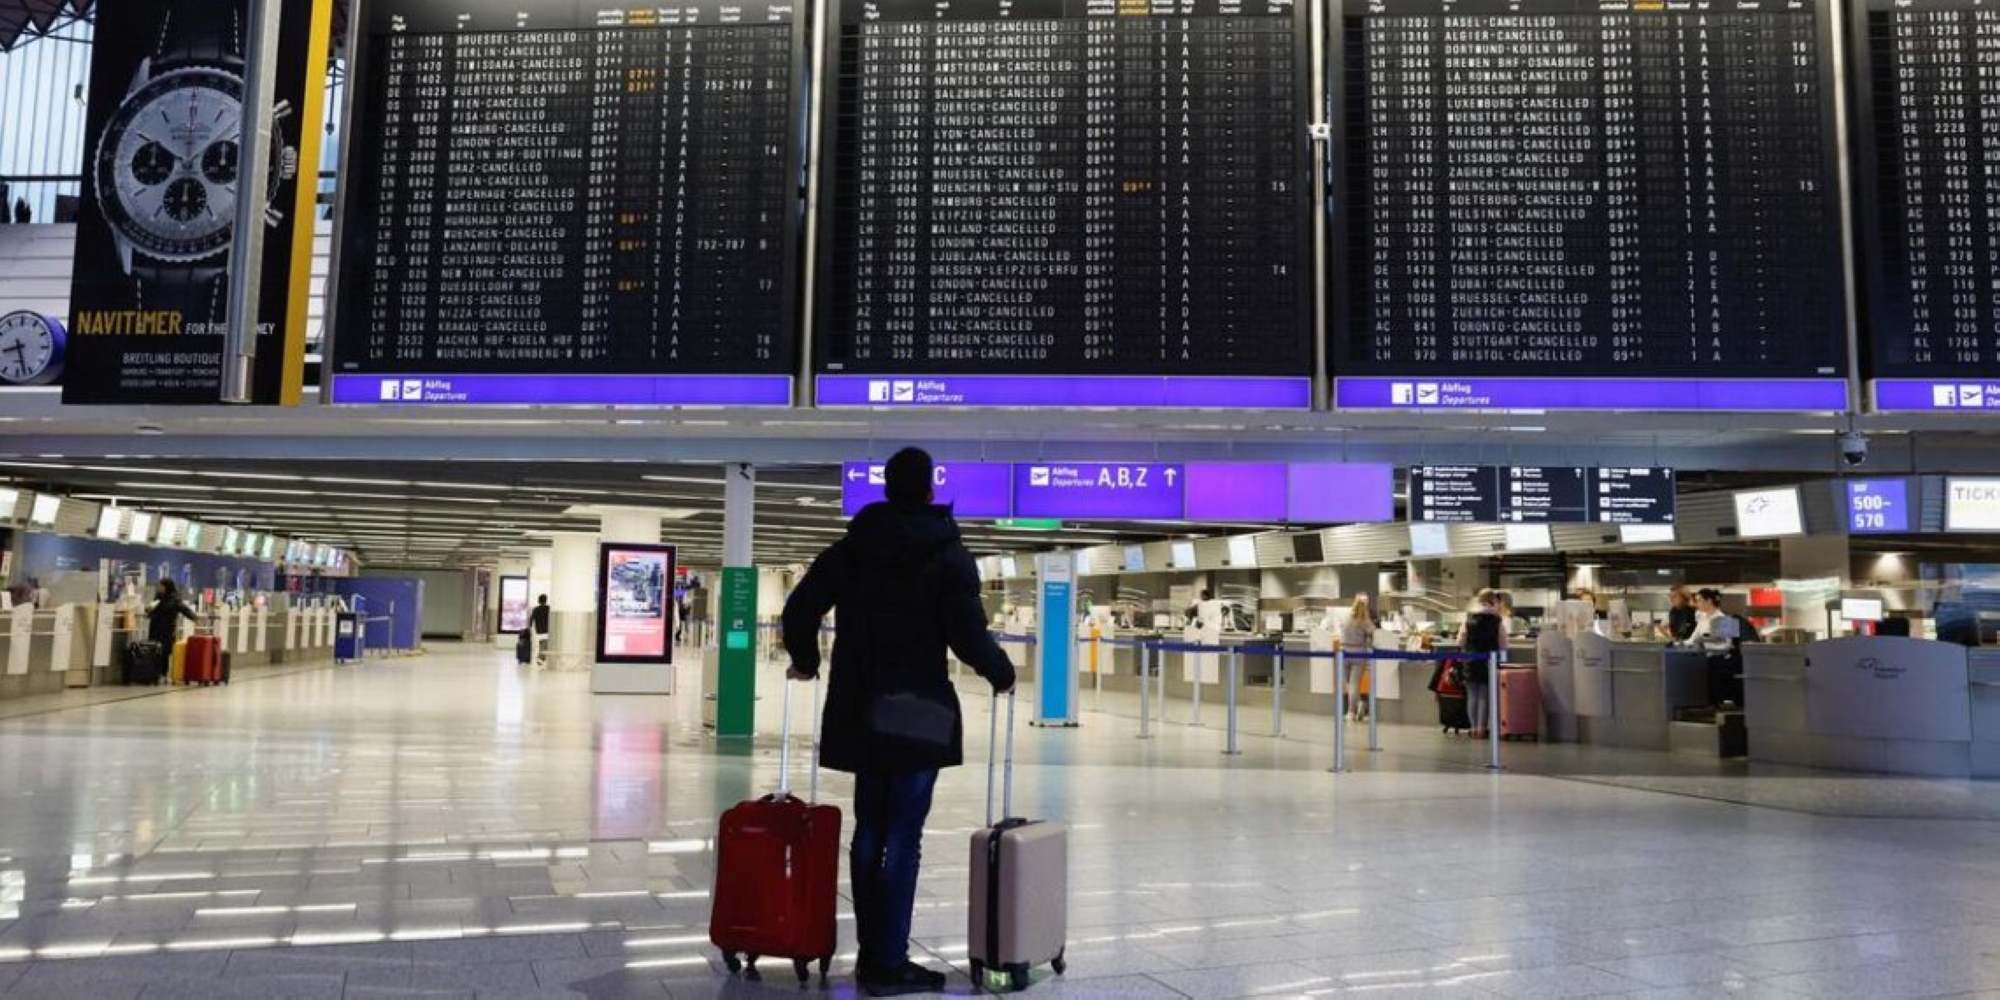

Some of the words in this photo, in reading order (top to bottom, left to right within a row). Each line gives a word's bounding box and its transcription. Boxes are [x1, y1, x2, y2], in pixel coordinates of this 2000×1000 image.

[937, 21, 1057, 34] CHICAGO-CANCELLED
[1402, 18, 1428, 28] 1202
[1444, 17, 1555, 28] BASEL-CANCELLED
[1446, 30, 1564, 41] ALGIER-CANCELLED
[1898, 26, 1912, 37] LH
[457, 32, 576, 45] BRUESSEL-CANCELLED
[936, 34, 1057, 47] MAILAND-CANCELLED
[391, 50, 404, 60] LH
[425, 49, 442, 59] 174
[456, 45, 562, 58] BERLIN-CANCELLED
[935, 48, 1050, 60] BERLIN-CANCELLED
[1445, 43, 1549, 55] DORTMUND-KOELN
[417, 61, 441, 72] 1470
[456, 57, 582, 71] TIMISOARA-CANCELLED
[936, 61, 1071, 73] AMSTERDAM-CANCELLED
[417, 74, 440, 84] 1402
[455, 70, 582, 83] FUERTEVEN-CANCELLED
[1446, 71, 1460, 82] LA
[1469, 70, 1587, 81] ROMANA-CANCELLED
[1941, 66, 1961, 77] 122
[935, 74, 1050, 86] NANTES-CANCELLED
[1941, 80, 1962, 91] 244
[935, 87, 1064, 100] SALZBURG-CANCELLED
[1446, 84, 1526, 95] DUESSELDORF
[453, 97, 546, 109] WIEN-CANCELLED
[1447, 98, 1589, 109] LUXEMBURG-CANCELLED
[1901, 95, 1915, 106] DE
[935, 101, 1057, 113] ZUERICH-CANCELLED
[452, 110, 545, 122] PISA-CANCELLED
[935, 114, 1057, 126] VENEDIG-CANCELLED
[1447, 111, 1582, 122] MUENSTER-CANCELLED
[451, 123, 564, 135] HAMBURG-CANCELLED
[934, 128, 1034, 140] LYON-CANCELLED
[1373, 126, 1387, 137] LH
[1411, 126, 1432, 136] 370
[451, 136, 557, 148] LONDON-CANCELLED
[933, 142, 1041, 153] PALMA-CANCELLED
[1412, 140, 1432, 150] 142
[1448, 139, 1591, 150] NUERNBERG-CANCELLED
[934, 155, 1034, 167] WIEN-CANCELLED
[1449, 153, 1583, 164] LISSABON-CANCELLED
[1946, 151, 1966, 161] 440
[449, 162, 542, 174] GRAZ-CANCELLED
[1413, 167, 1432, 178] 417
[1449, 167, 1569, 178] ZAGREB-CANCELLED
[933, 169, 1064, 180] BRUESSEL-CANCELLED
[449, 175, 548, 187] TURIN-CANCELLED
[447, 188, 575, 200] KOPENHAGE-CANCELLED
[1940, 193, 1969, 204] 1142
[932, 196, 1056, 207] HAMBURG-CANCELLED
[1449, 195, 1592, 205] GOETEBORG-CANCELLED
[446, 201, 573, 213] MARSEILLE-CANCELLED
[932, 210, 1056, 221] LEIPZIG-CANCELLED
[1449, 209, 1585, 219] HELSINKI-CANCELLED
[860, 224, 873, 235] LH
[932, 223, 1055, 235] MAILAND-CANCELLED
[1374, 223, 1389, 233] LH
[1407, 223, 1433, 233] 1322
[1452, 223, 1563, 233] TUNIS-CANCELLED
[1950, 222, 1971, 233] 454
[444, 228, 565, 239] MUENCHEN-CANCELLED
[931, 237, 1048, 248] LONDON-CANCELLED
[1452, 237, 1563, 247] IZMIR-CANCELLED
[931, 251, 1070, 262] LJUBLJANA-CANCELLED
[1451, 251, 1564, 261] PARIS-CANCELLED
[1452, 265, 1594, 275] TENERIFFA-CANCELLED
[1911, 265, 1926, 276] LH
[1945, 265, 1973, 276] 1394
[930, 279, 1047, 290] LONDON-CANCELLED
[1375, 279, 1389, 289] EK
[1451, 279, 1564, 290] DUBAI-CANCELLED
[440, 295, 541, 305] PARIS-CANCELLED
[930, 293, 1033, 303] GENF-CANCELLED
[1451, 293, 1587, 304] BRUESSEL-CANCELLED
[439, 308, 540, 319] NIZZA-CANCELLED
[930, 307, 1054, 317] MAILAND-CANCELLED
[1453, 307, 1581, 318] ZUERICH-CANCELLED
[77, 310, 182, 335] NAVITIMER
[185, 323, 206, 335] FOR
[439, 322, 547, 332] KRAKAU-CANCELLED
[930, 321, 1033, 331] LINZ-CANCELLED
[1377, 321, 1390, 332] AC
[1414, 322, 1435, 332] 841
[1454, 322, 1581, 332] TORONTO-CANCELLED
[1914, 323, 1929, 333] AA
[1956, 322, 1977, 333] 705
[928, 335, 1054, 345] DRESDEN-CANCELLED
[1376, 336, 1391, 346] LH
[1453, 336, 1597, 347] STUTTGART-CANCELLED
[123, 353, 171, 365] BREITLING
[173, 353, 221, 365] BOUTIQUE
[928, 348, 1047, 359] BREMEN-CANCELLED
[1453, 350, 1582, 361] BRISTOL-CANCELLED
[1916, 352, 1931, 362] LH
[1958, 351, 1979, 362] 100
[424, 380, 450, 391] Abflug
[917, 381, 945, 392] Abflug
[1442, 383, 1471, 394] Abflug
[424, 391, 467, 402] Departures
[916, 392, 963, 403] Departures
[1441, 394, 1490, 405] Departures
[1053, 467, 1078, 477] Abflug
[1052, 477, 1093, 487] Departures
[1955, 486, 2000, 501] TICK
[1855, 513, 1884, 528] 570
